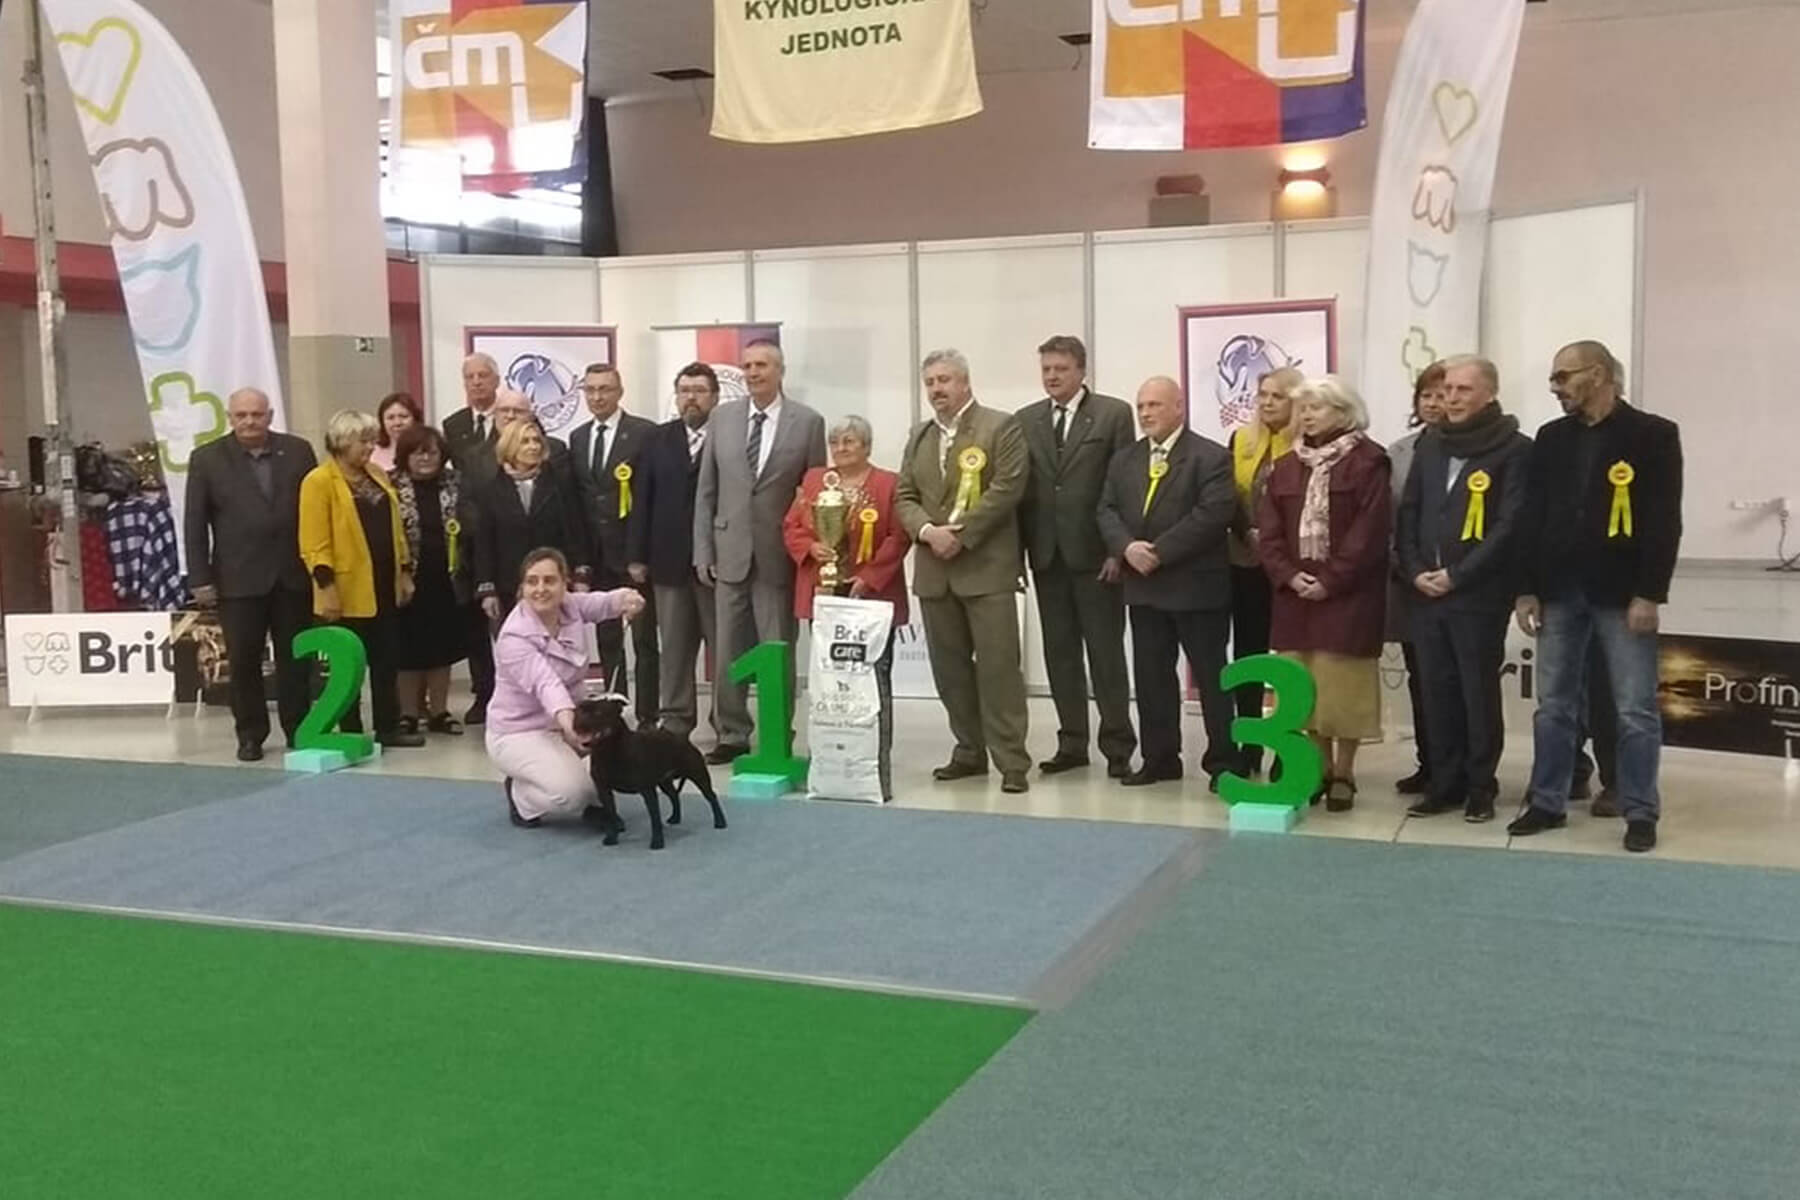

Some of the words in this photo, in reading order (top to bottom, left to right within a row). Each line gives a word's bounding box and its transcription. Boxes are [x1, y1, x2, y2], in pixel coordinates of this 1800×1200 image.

[781, 22, 902, 55] JEDNOTA
[78, 631, 175, 674] Brit
[833, 645, 863, 659] care
[834, 625, 867, 641] Brit
[292, 625, 374, 760] 2
[728, 640, 809, 790] 1
[1218, 653, 1326, 812] 3
